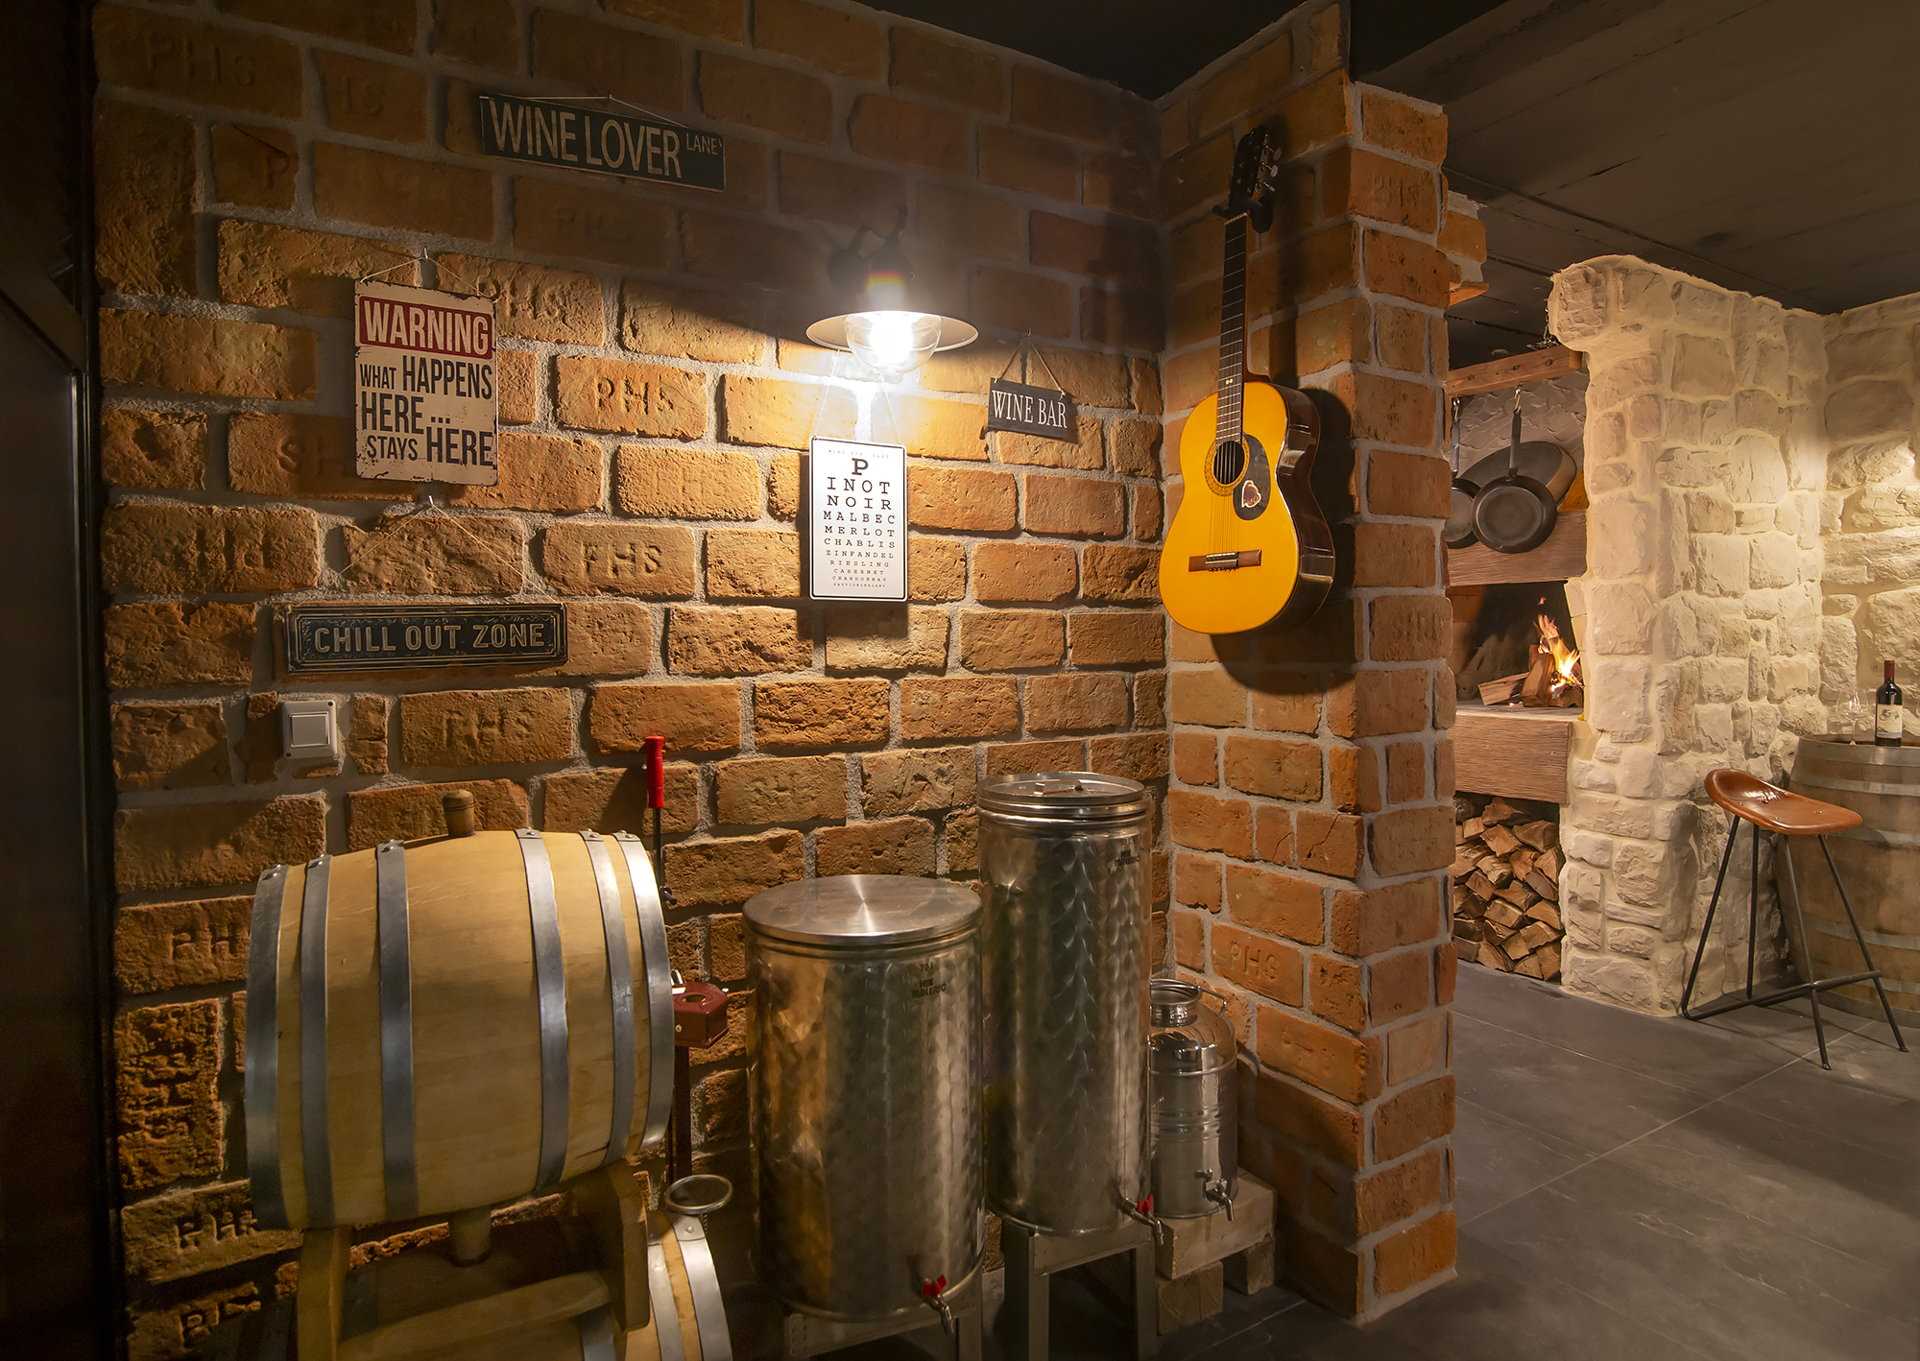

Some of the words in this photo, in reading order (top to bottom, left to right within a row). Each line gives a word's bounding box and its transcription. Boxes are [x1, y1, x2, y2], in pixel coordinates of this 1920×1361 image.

[488, 99, 579, 162] WINE
[584, 114, 683, 179] LOVER
[686, 132, 721, 156] LANE
[363, 300, 489, 356] WARNING
[360, 363, 397, 390] WHAT
[402, 354, 493, 400] HAPPENS
[991, 389, 1034, 424] WINE
[1038, 398, 1068, 429] BAR
[366, 434, 419, 462] STAYS
[426, 425, 494, 467] HERE
[851, 457, 869, 476] P
[827, 476, 890, 495] INOT
[827, 495, 892, 511] NOIR
[823, 510, 895, 525] MALBEC
[824, 525, 895, 538] MERLOT
[824, 537, 895, 549] CHABLIS
[314, 626, 397, 653] CHILL
[405, 625, 462, 651] OUT
[472, 623, 545, 649] ZONE
